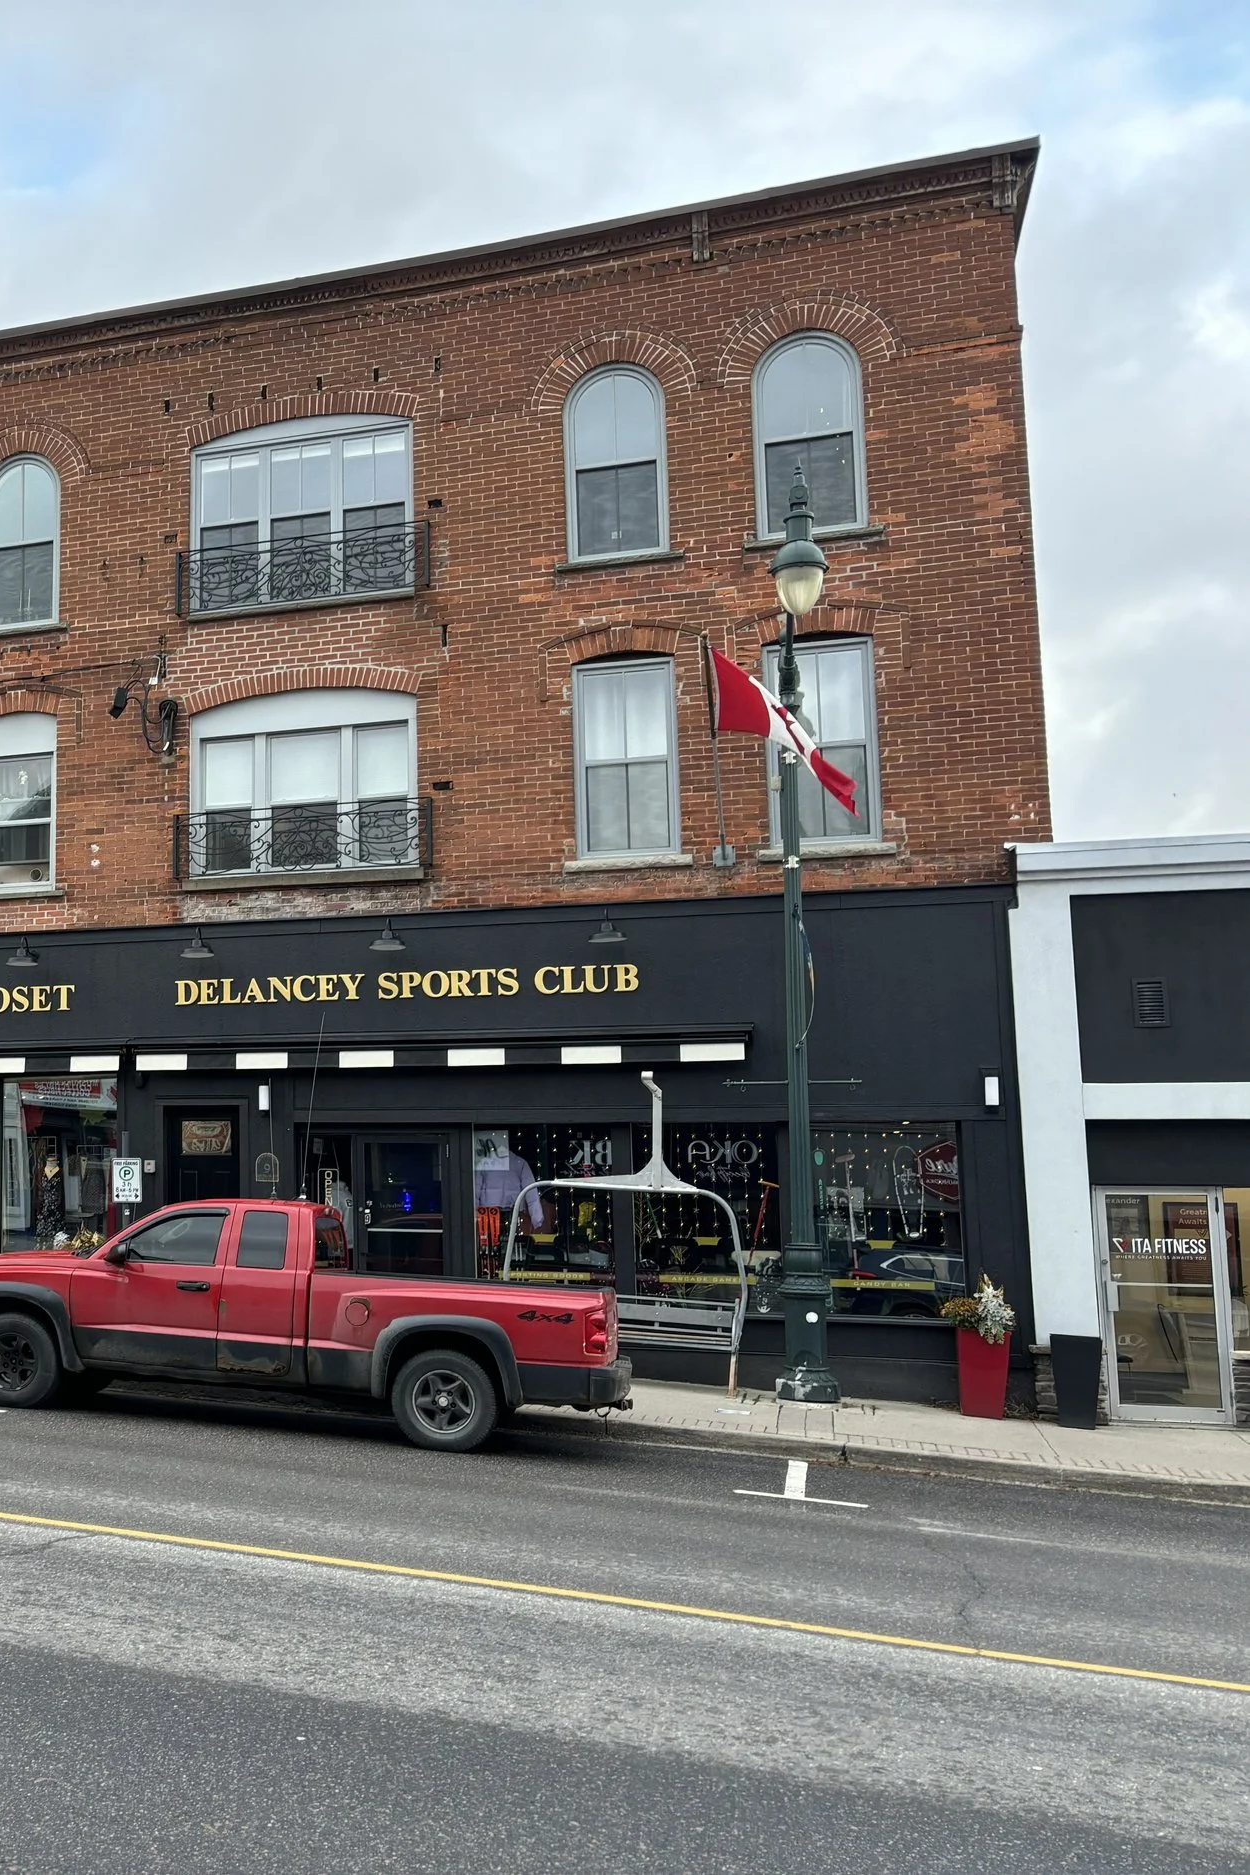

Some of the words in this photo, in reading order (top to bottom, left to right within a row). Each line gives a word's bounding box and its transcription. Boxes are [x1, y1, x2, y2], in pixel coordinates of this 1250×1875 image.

[175, 973, 365, 1006] DELANCEY
[378, 968, 520, 1000] SPORTS
[534, 963, 639, 995] CLUB
[124, 1170, 131, 1178] P
[324, 1170, 333, 1206] OPEN
[1154, 1238, 1207, 1254] FITNESS
[517, 1310, 574, 1325] 4x4
